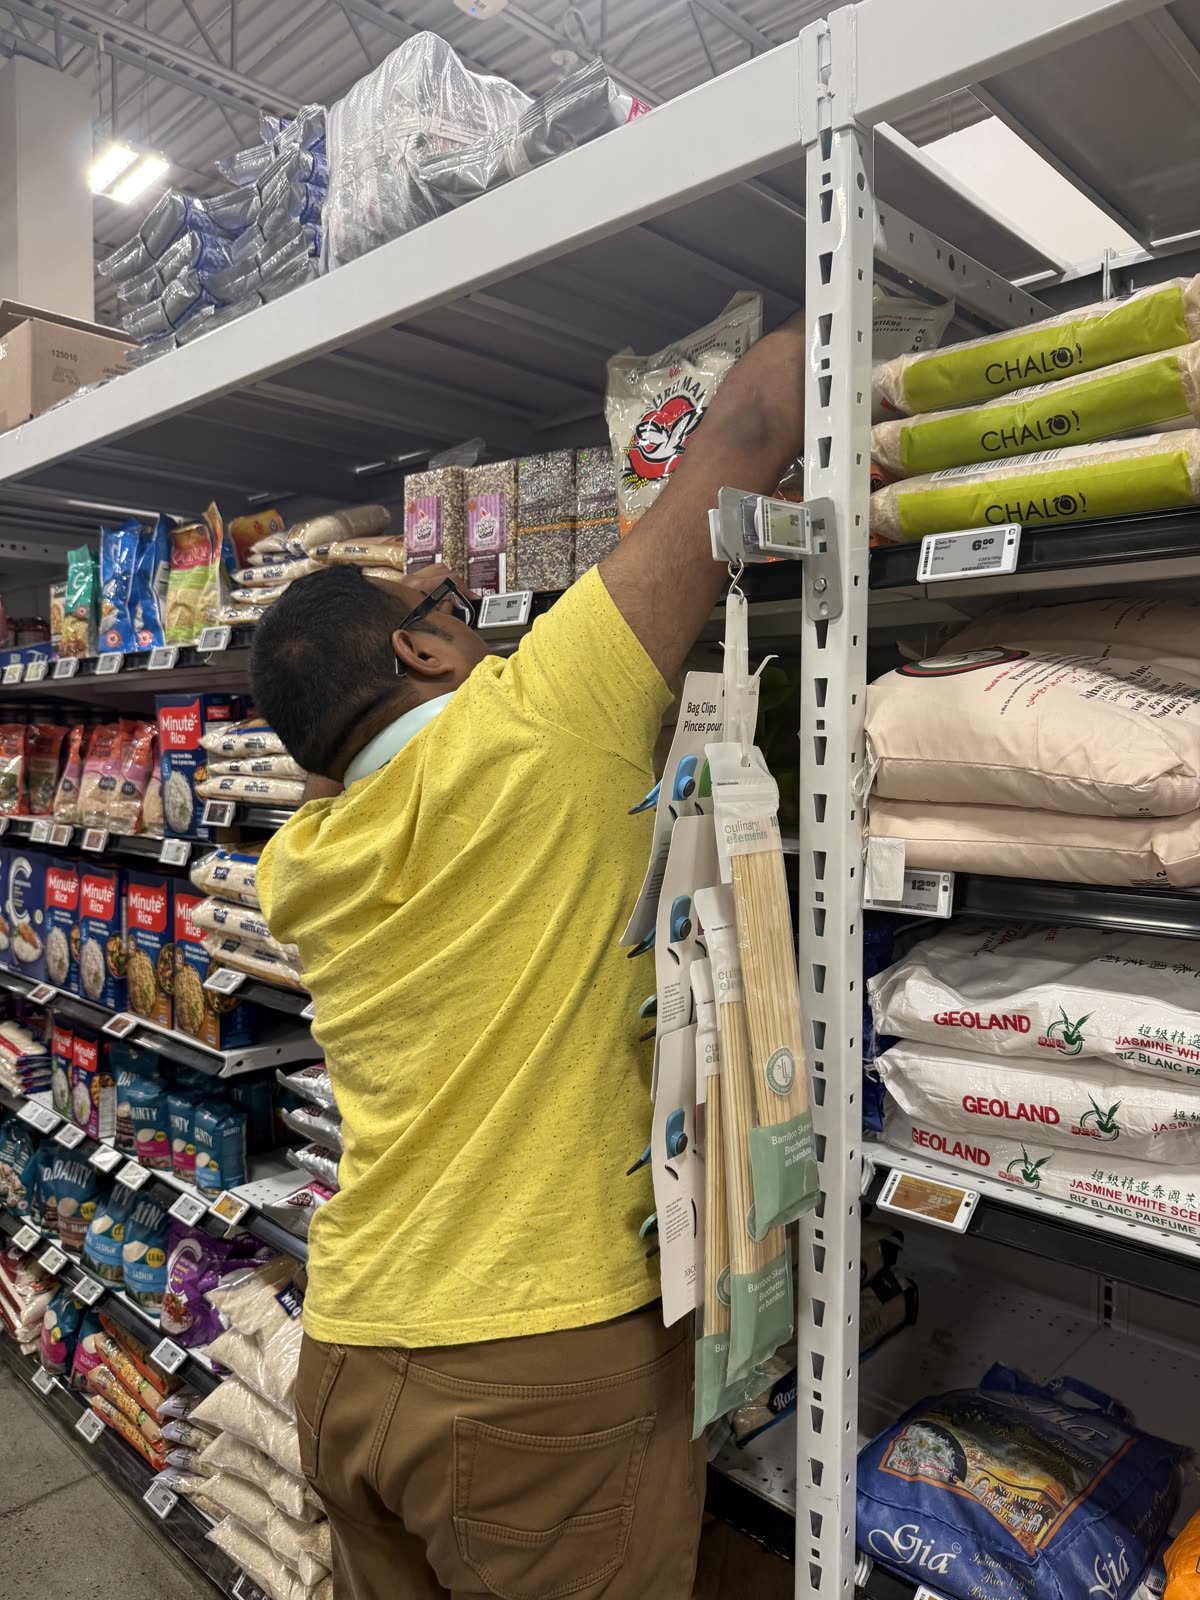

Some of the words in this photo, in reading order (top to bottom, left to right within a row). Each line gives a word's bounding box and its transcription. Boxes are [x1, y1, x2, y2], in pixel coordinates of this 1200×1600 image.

[51, 349, 78, 362] 125010
[986, 343, 1084, 385] CHALO!
[981, 410, 1082, 452] CHALO!
[985, 492, 1087, 526] CHALO!
[687, 702, 700, 716] Bag
[701, 702, 717, 715] Clips
[162, 717, 195, 732] Minute
[683, 720, 706, 732] Pinces
[706, 722, 722, 734] pour
[171, 732, 187, 744] Rice
[725, 820, 760, 834] culinary
[727, 831, 768, 844] elements
[48, 874, 76, 893] Minute
[83, 883, 112, 902] Minute
[54, 892, 68, 903] Rice
[129, 891, 162, 912] Minute
[89, 902, 104, 913] Rice
[136, 910, 153, 925] Rice
[185, 921, 201, 937] Rice
[933, 1011, 1031, 1033] GEOLAND
[1115, 1036, 1173, 1054] JASMINE
[1138, 1053, 1182, 1072] BLANC
[962, 1095, 1061, 1125] GEOLAND
[911, 1127, 990, 1167] GEOLAND
[1069, 1193, 1088, 1205] RIZ
[1091, 1199, 1132, 1218] BLANC
[1070, 1179, 1122, 1201] JASMINE
[1126, 1192, 1167, 1213] WHITE
[868, 1524, 957, 1574] Gia
